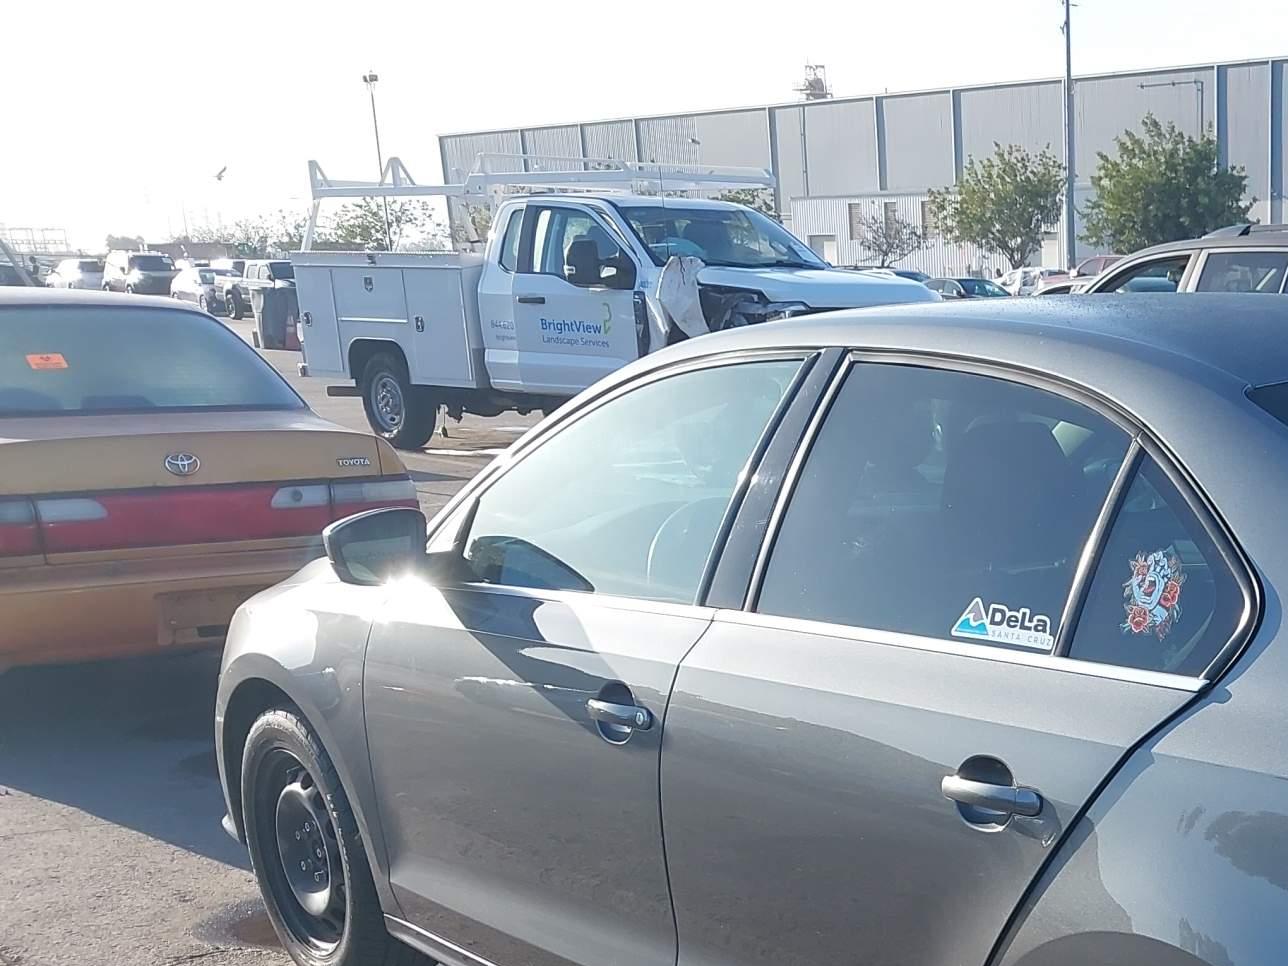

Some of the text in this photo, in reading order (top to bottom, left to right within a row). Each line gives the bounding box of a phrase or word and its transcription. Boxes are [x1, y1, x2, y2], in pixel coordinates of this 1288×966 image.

[540, 318, 602, 334] BrightView
[542, 335, 610, 348] Landscape Services
[336, 458, 371, 466] TOYOTA
[989, 607, 1048, 634] DeLa
[991, 630, 1052, 647] SANTA CRUZ
